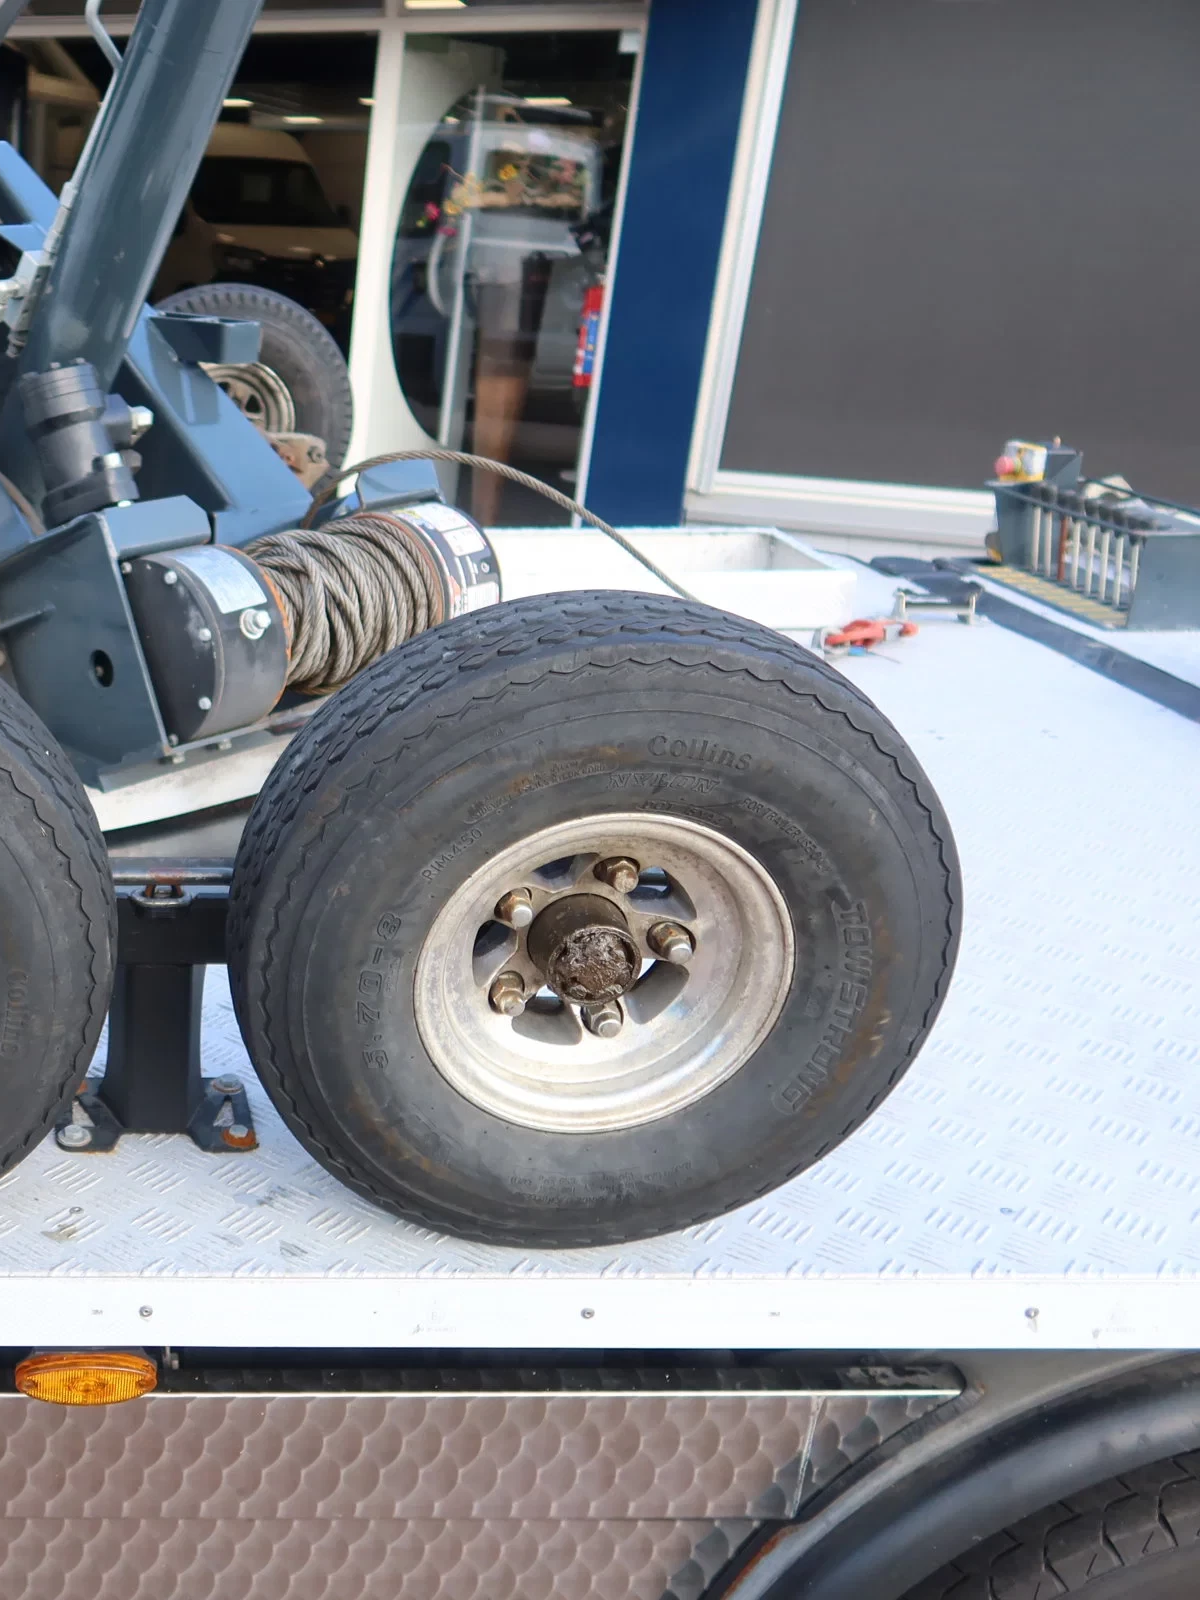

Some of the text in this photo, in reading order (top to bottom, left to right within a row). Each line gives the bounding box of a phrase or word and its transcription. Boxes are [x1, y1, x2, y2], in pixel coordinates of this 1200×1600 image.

[646, 733, 754, 773] Collins
[607, 769, 720, 796] NYLON
[741, 796, 763, 813] FOR
[763, 808, 801, 839] TRAILER
[798, 834, 817, 852] USE
[358, 912, 402, 1070] 5.70-8
[778, 901, 872, 1111] TOWSTRONG
